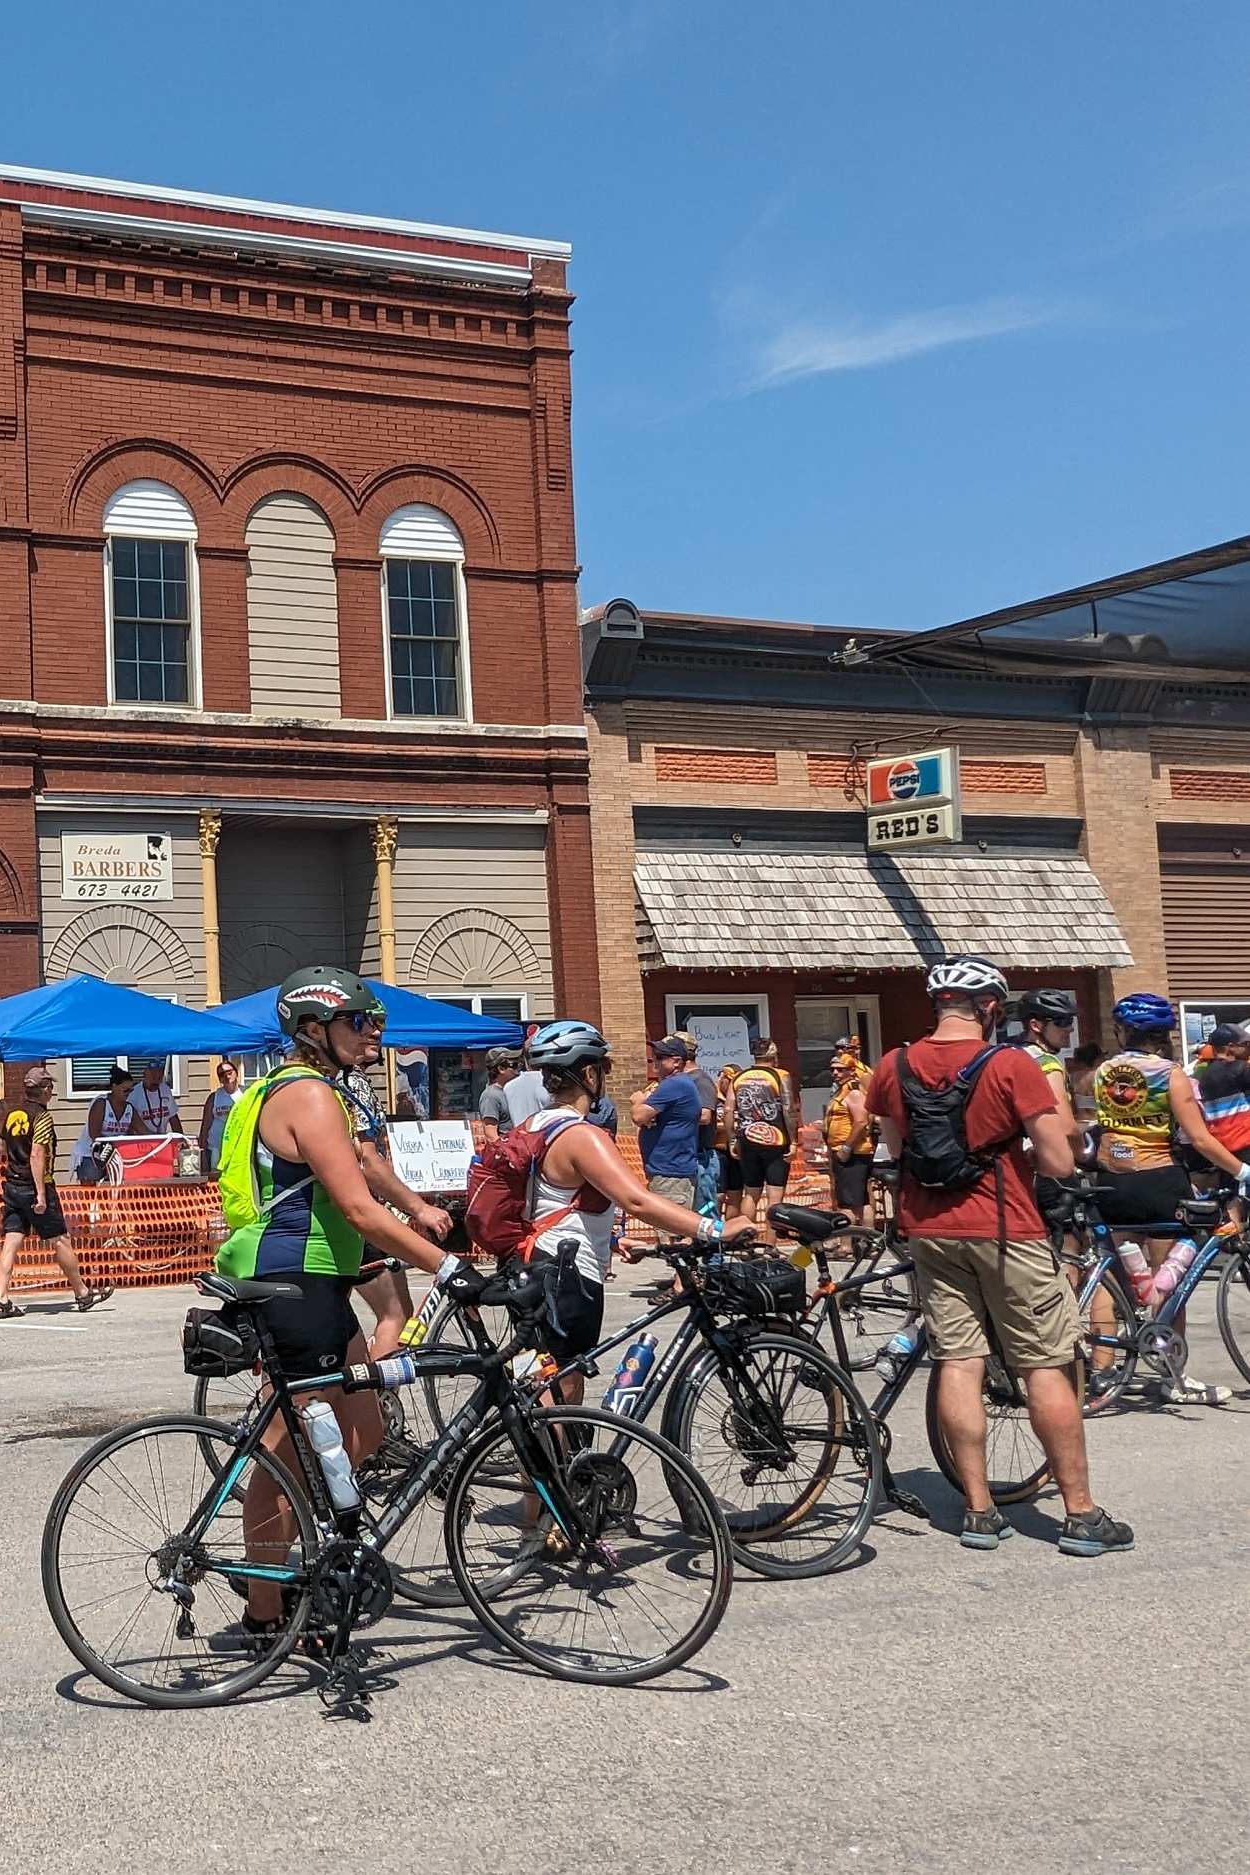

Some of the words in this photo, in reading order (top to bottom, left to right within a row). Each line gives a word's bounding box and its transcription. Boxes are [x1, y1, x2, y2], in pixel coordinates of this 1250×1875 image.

[890, 774, 920, 787] PEPSI
[876, 814, 939, 840] RED'S
[77, 844, 122, 856] Breda
[72, 860, 162, 877] BARBERS
